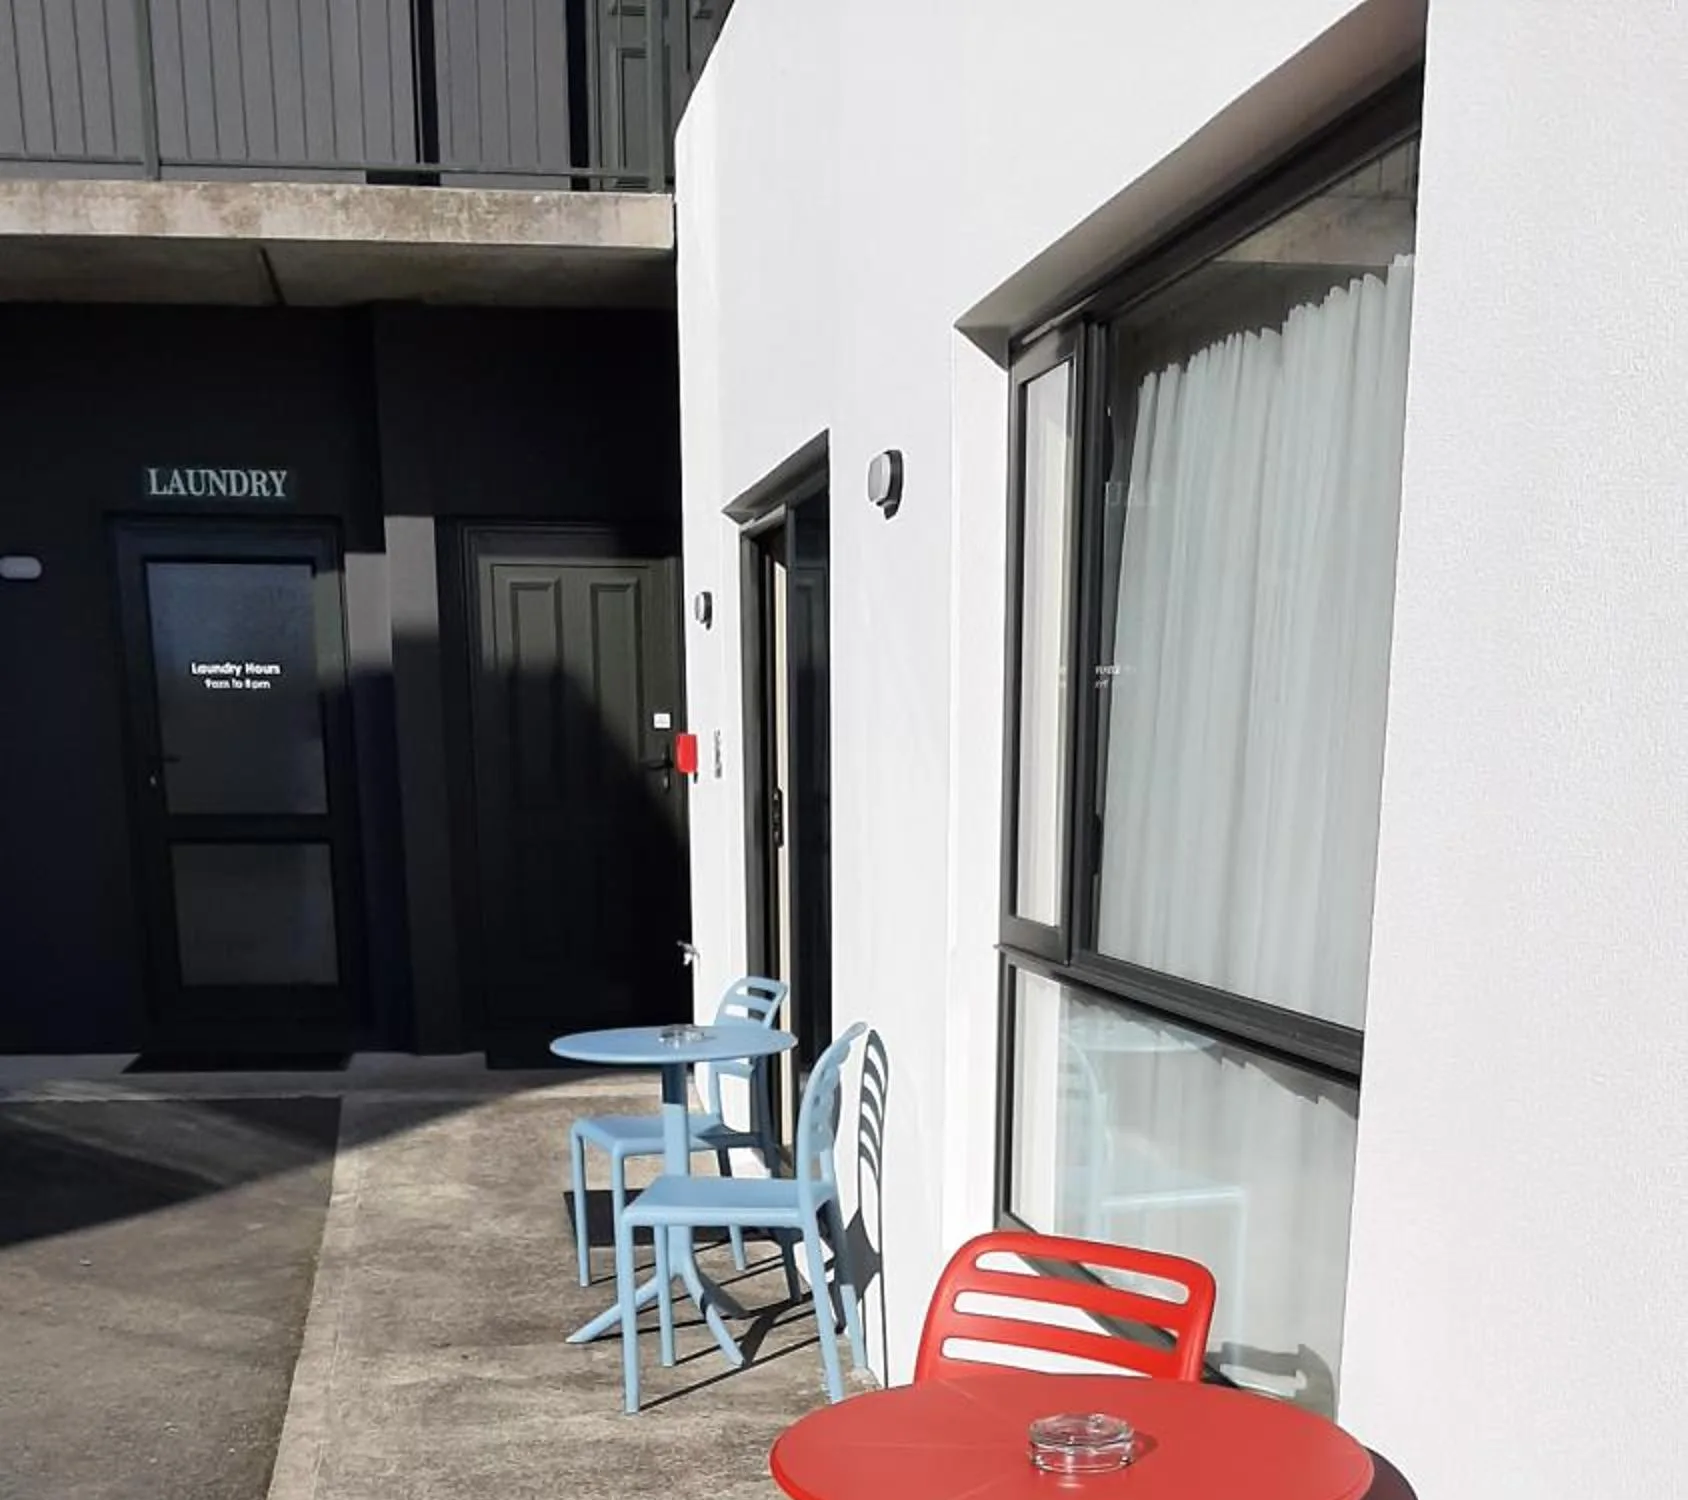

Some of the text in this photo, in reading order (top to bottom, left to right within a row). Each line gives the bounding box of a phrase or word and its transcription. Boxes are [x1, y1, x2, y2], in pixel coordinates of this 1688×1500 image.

[147, 467, 288, 497] LAUNDRY
[191, 662, 281, 677] Laundry Hours
